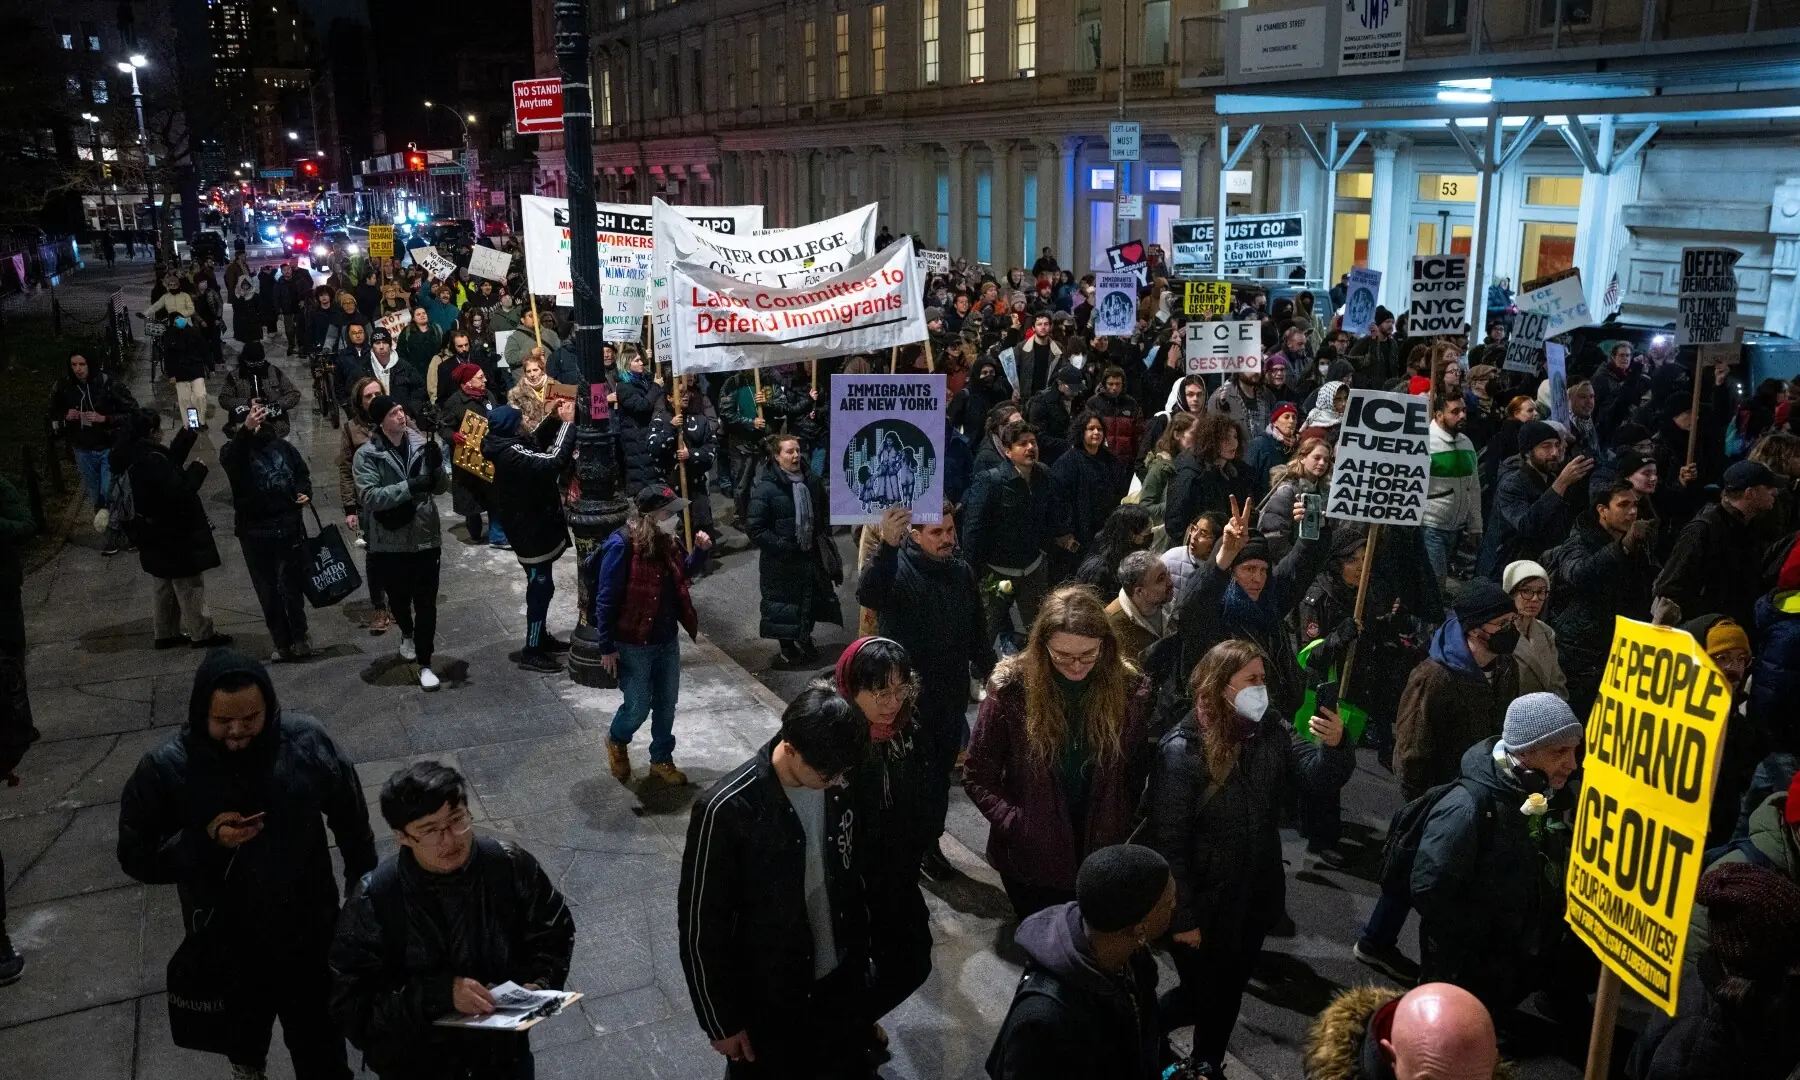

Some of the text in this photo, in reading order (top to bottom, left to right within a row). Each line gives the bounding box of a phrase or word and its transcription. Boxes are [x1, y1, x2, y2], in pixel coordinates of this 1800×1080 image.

[1360, 0, 1389, 29] JMA
[1264, 22, 1287, 31] CHAMBERS
[1290, 19, 1306, 28] STREET
[518, 84, 562, 96] NO STANDI
[520, 98, 553, 109] Anytime
[1442, 182, 1458, 196] 53
[1192, 227, 1214, 240] ICE
[1260, 222, 1286, 236] GO!
[381, 241, 392, 249] OUT
[758, 231, 848, 264] COLLEGE
[1177, 244, 1204, 253] Whole
[1234, 241, 1265, 251] Fascist
[1267, 239, 1299, 249] Regime
[927, 252, 947, 260] TROOPS
[1109, 249, 1125, 269] I
[1246, 250, 1272, 258] NOW!
[422, 259, 438, 275] NYC
[430, 259, 438, 267] IN
[437, 257, 455, 271] TROOPS
[1413, 258, 1465, 280] ICE
[692, 269, 904, 309] Labor Committee to
[1190, 283, 1216, 294] ICE
[1413, 281, 1466, 292] OUT OF
[617, 302, 628, 312] IS
[1189, 294, 1226, 304] TRUMP'S
[1411, 298, 1465, 315] NYC
[1680, 297, 1737, 313] IT'S TIME FOR
[381, 313, 402, 327] NOT
[697, 293, 902, 334] Defend Immigrants
[1683, 312, 1730, 329] A GENERAL
[1410, 316, 1463, 331] NOW
[1516, 311, 1549, 341] ICE
[1688, 327, 1724, 343] STRIKE!
[1188, 356, 1258, 371] GESTAPO
[847, 384, 931, 397] IMMIGRANTS
[840, 398, 938, 411] ARE NEW YORK!
[1345, 397, 1429, 436] ICE
[1341, 432, 1429, 456] FUERA
[1338, 458, 1426, 479] AHORA
[1335, 472, 1424, 494] AHORA
[1333, 487, 1421, 508] AHORA
[1330, 501, 1418, 521] AHORA
[312, 561, 346, 586] DUMBO
[315, 561, 320, 570] I
[316, 568, 348, 592] MARKET
[1624, 640, 1723, 722] PEOPLE
[1586, 696, 1707, 804] DEMAND
[1575, 781, 1695, 920] ICE OUT
[1579, 869, 1600, 909] OUR
[1599, 884, 1678, 966] COMMUNITIES!
[1627, 947, 1668, 993] LIBERATION
